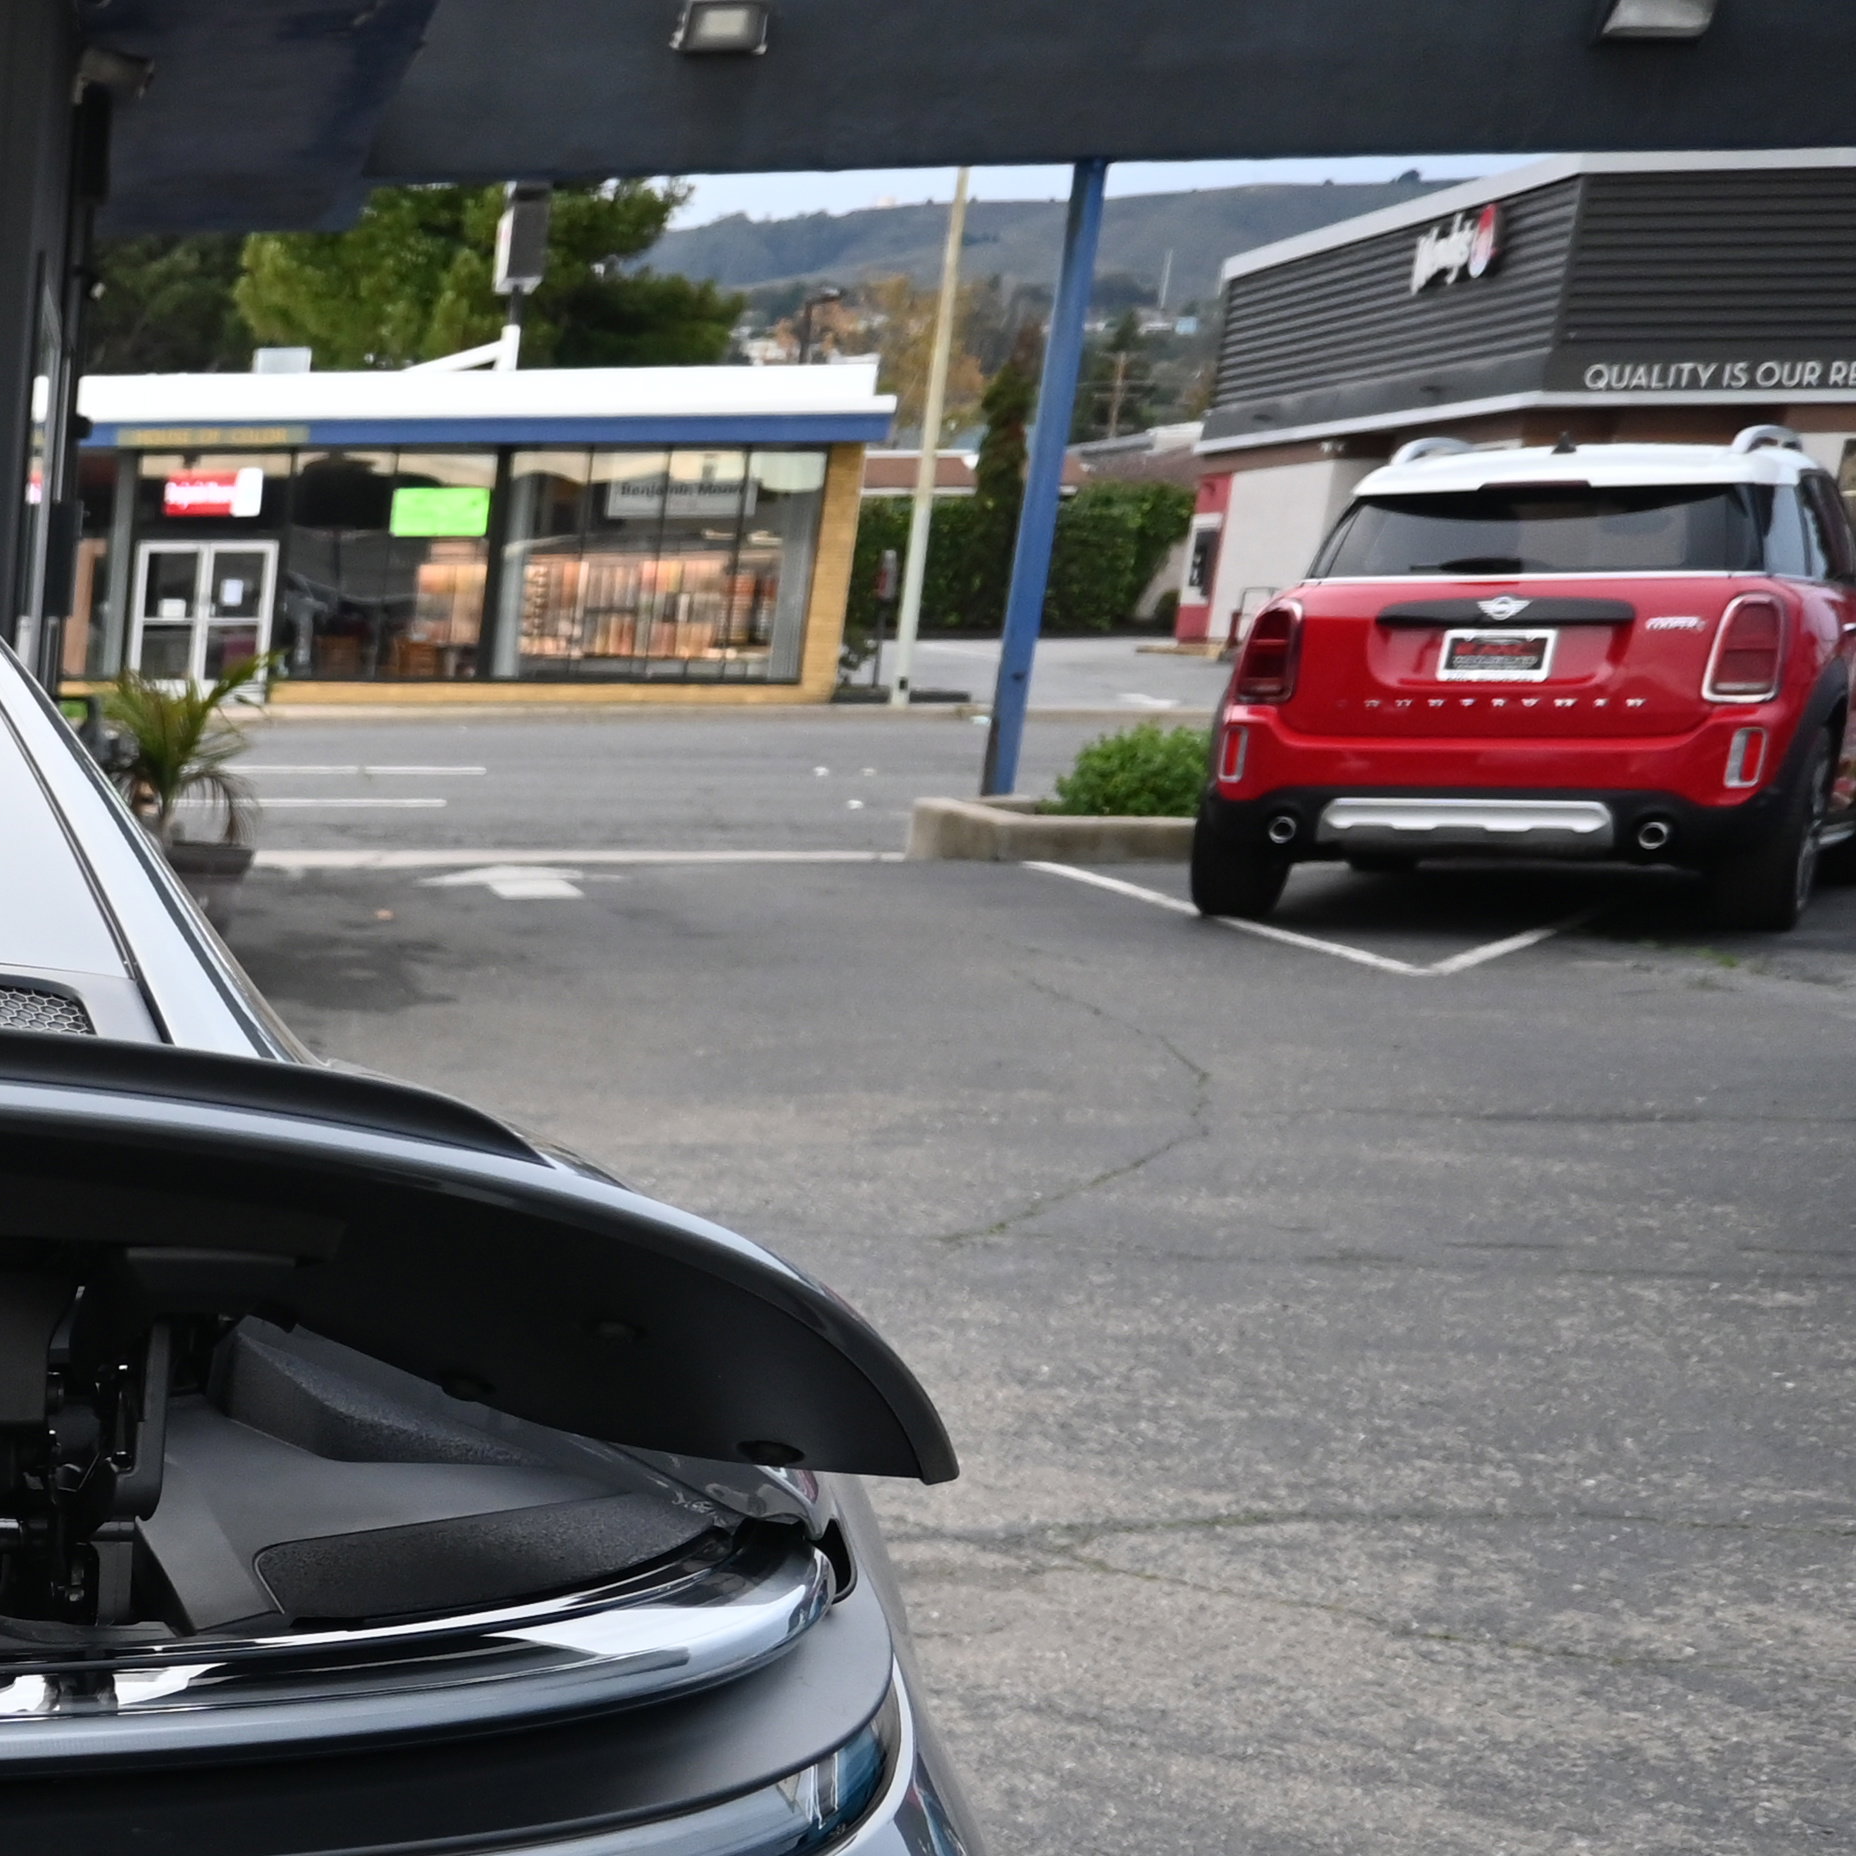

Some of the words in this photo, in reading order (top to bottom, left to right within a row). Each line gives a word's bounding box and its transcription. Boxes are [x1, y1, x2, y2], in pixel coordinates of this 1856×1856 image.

[1584, 362, 1717, 391] QUALITY
[1722, 361, 1751, 388] IS
[1755, 360, 1822, 388] OUR
